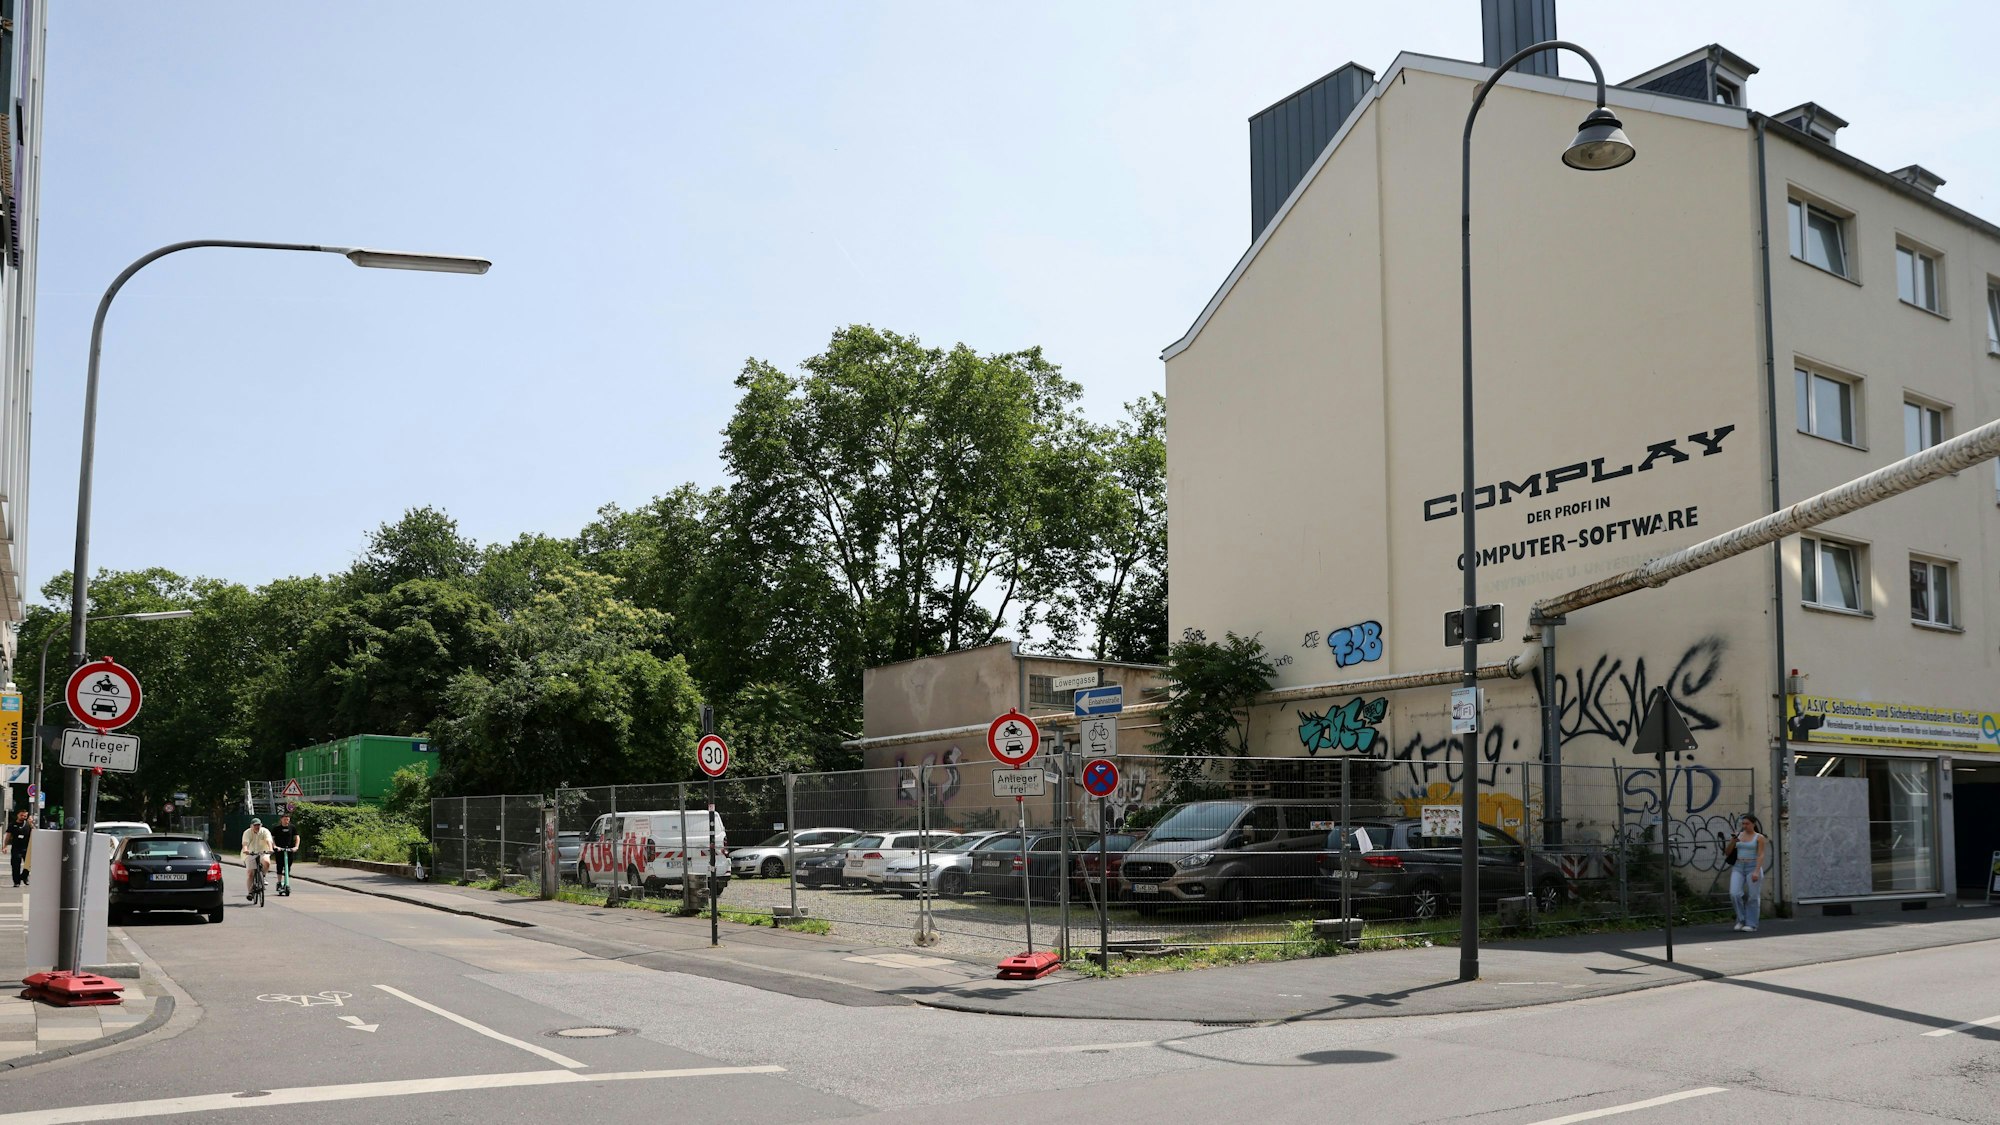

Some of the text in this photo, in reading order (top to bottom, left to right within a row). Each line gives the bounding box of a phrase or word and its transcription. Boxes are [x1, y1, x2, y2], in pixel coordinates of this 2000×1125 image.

[1424, 424, 1735, 522] COMPLAY
[1527, 496, 1611, 524] DER PROFI IN
[1054, 676, 1096, 688] Löwengasse
[1088, 696, 1120, 706] Einbahnstraße
[1876, 705, 1888, 718] und
[10, 721, 19, 760] COMEDIA
[72, 737, 130, 754] Anlieger
[89, 752, 112, 765] frei
[704, 746, 723, 765] 30
[997, 774, 1038, 784] Anlieger
[1009, 783, 1027, 794] frei
